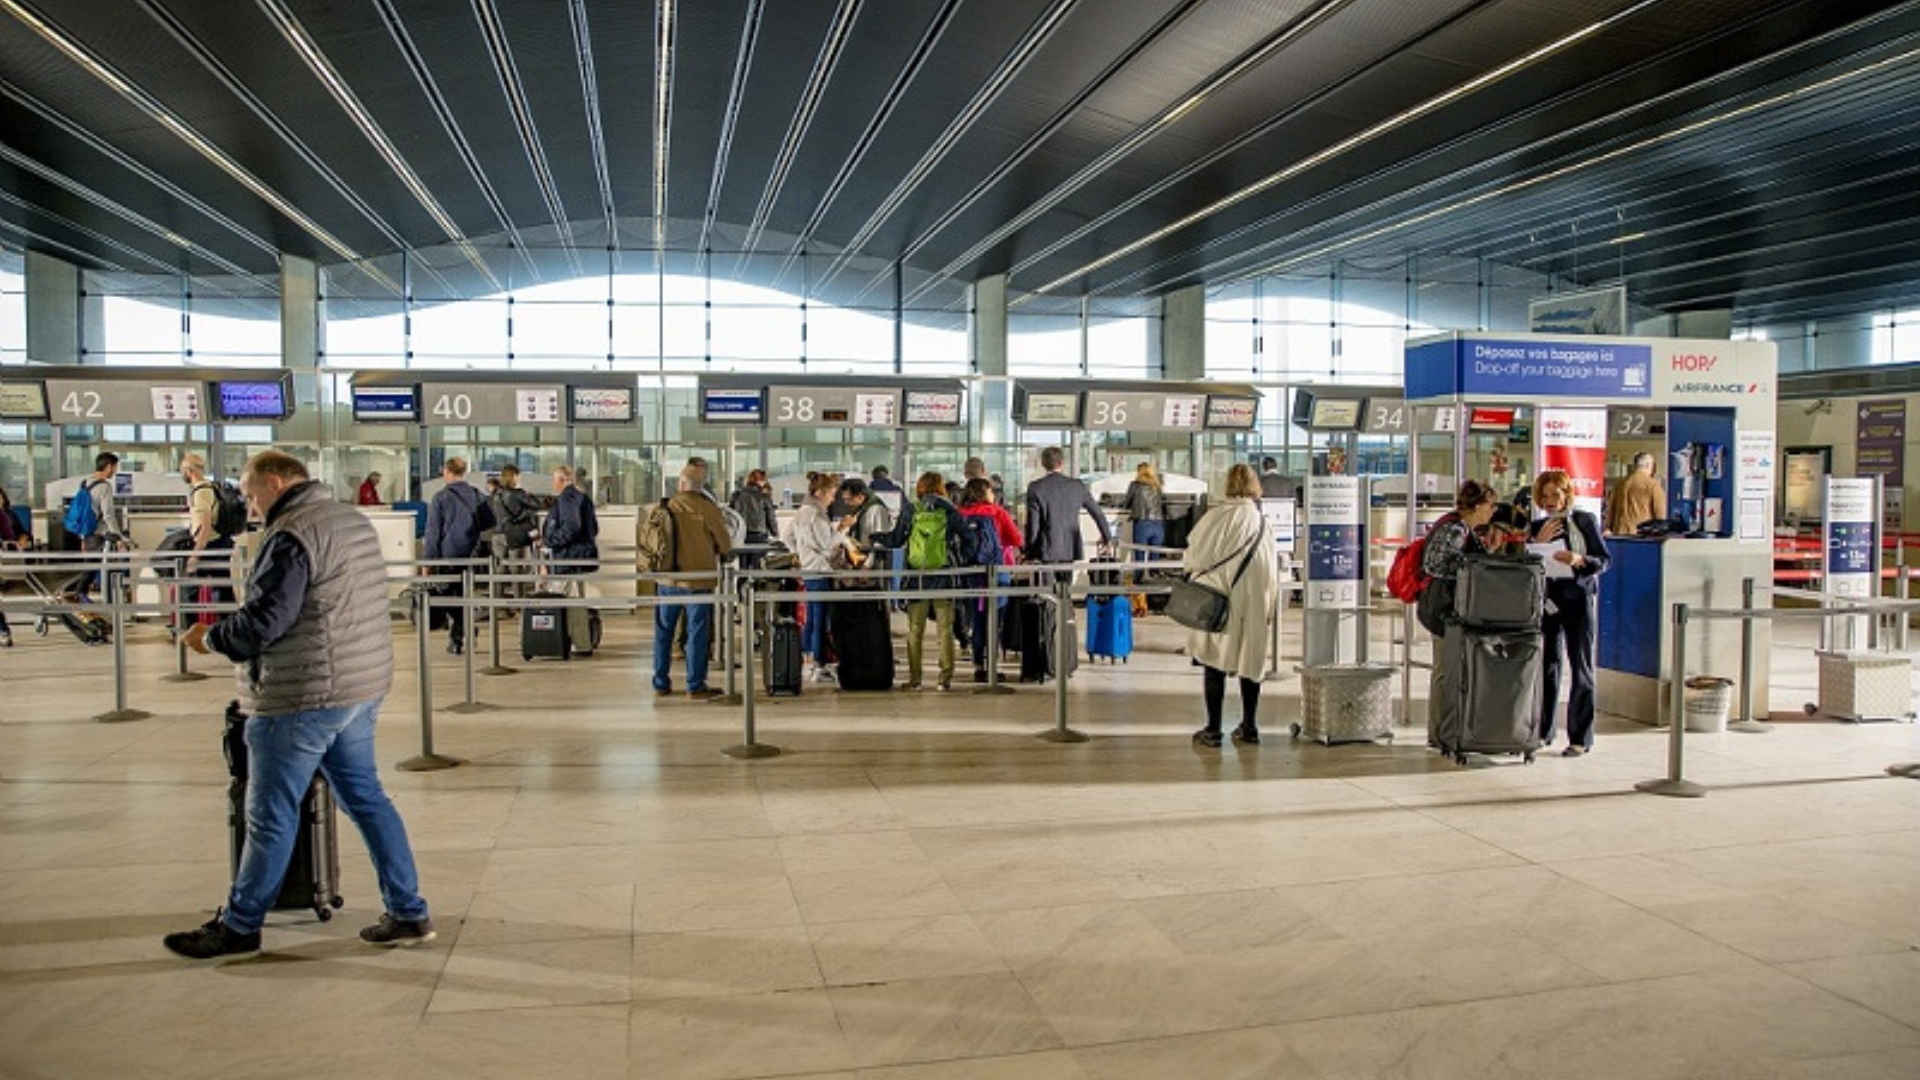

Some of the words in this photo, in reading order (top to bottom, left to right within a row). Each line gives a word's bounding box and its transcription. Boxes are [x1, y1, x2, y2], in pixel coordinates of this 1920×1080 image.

[1475, 361, 1521, 376] Drop-off
[60, 391, 104, 418] 42
[433, 394, 472, 420] 40
[777, 396, 815, 422] 38
[1094, 401, 1128, 425] 36
[1373, 406, 1403, 429] 34
[1617, 413, 1646, 434] 32
